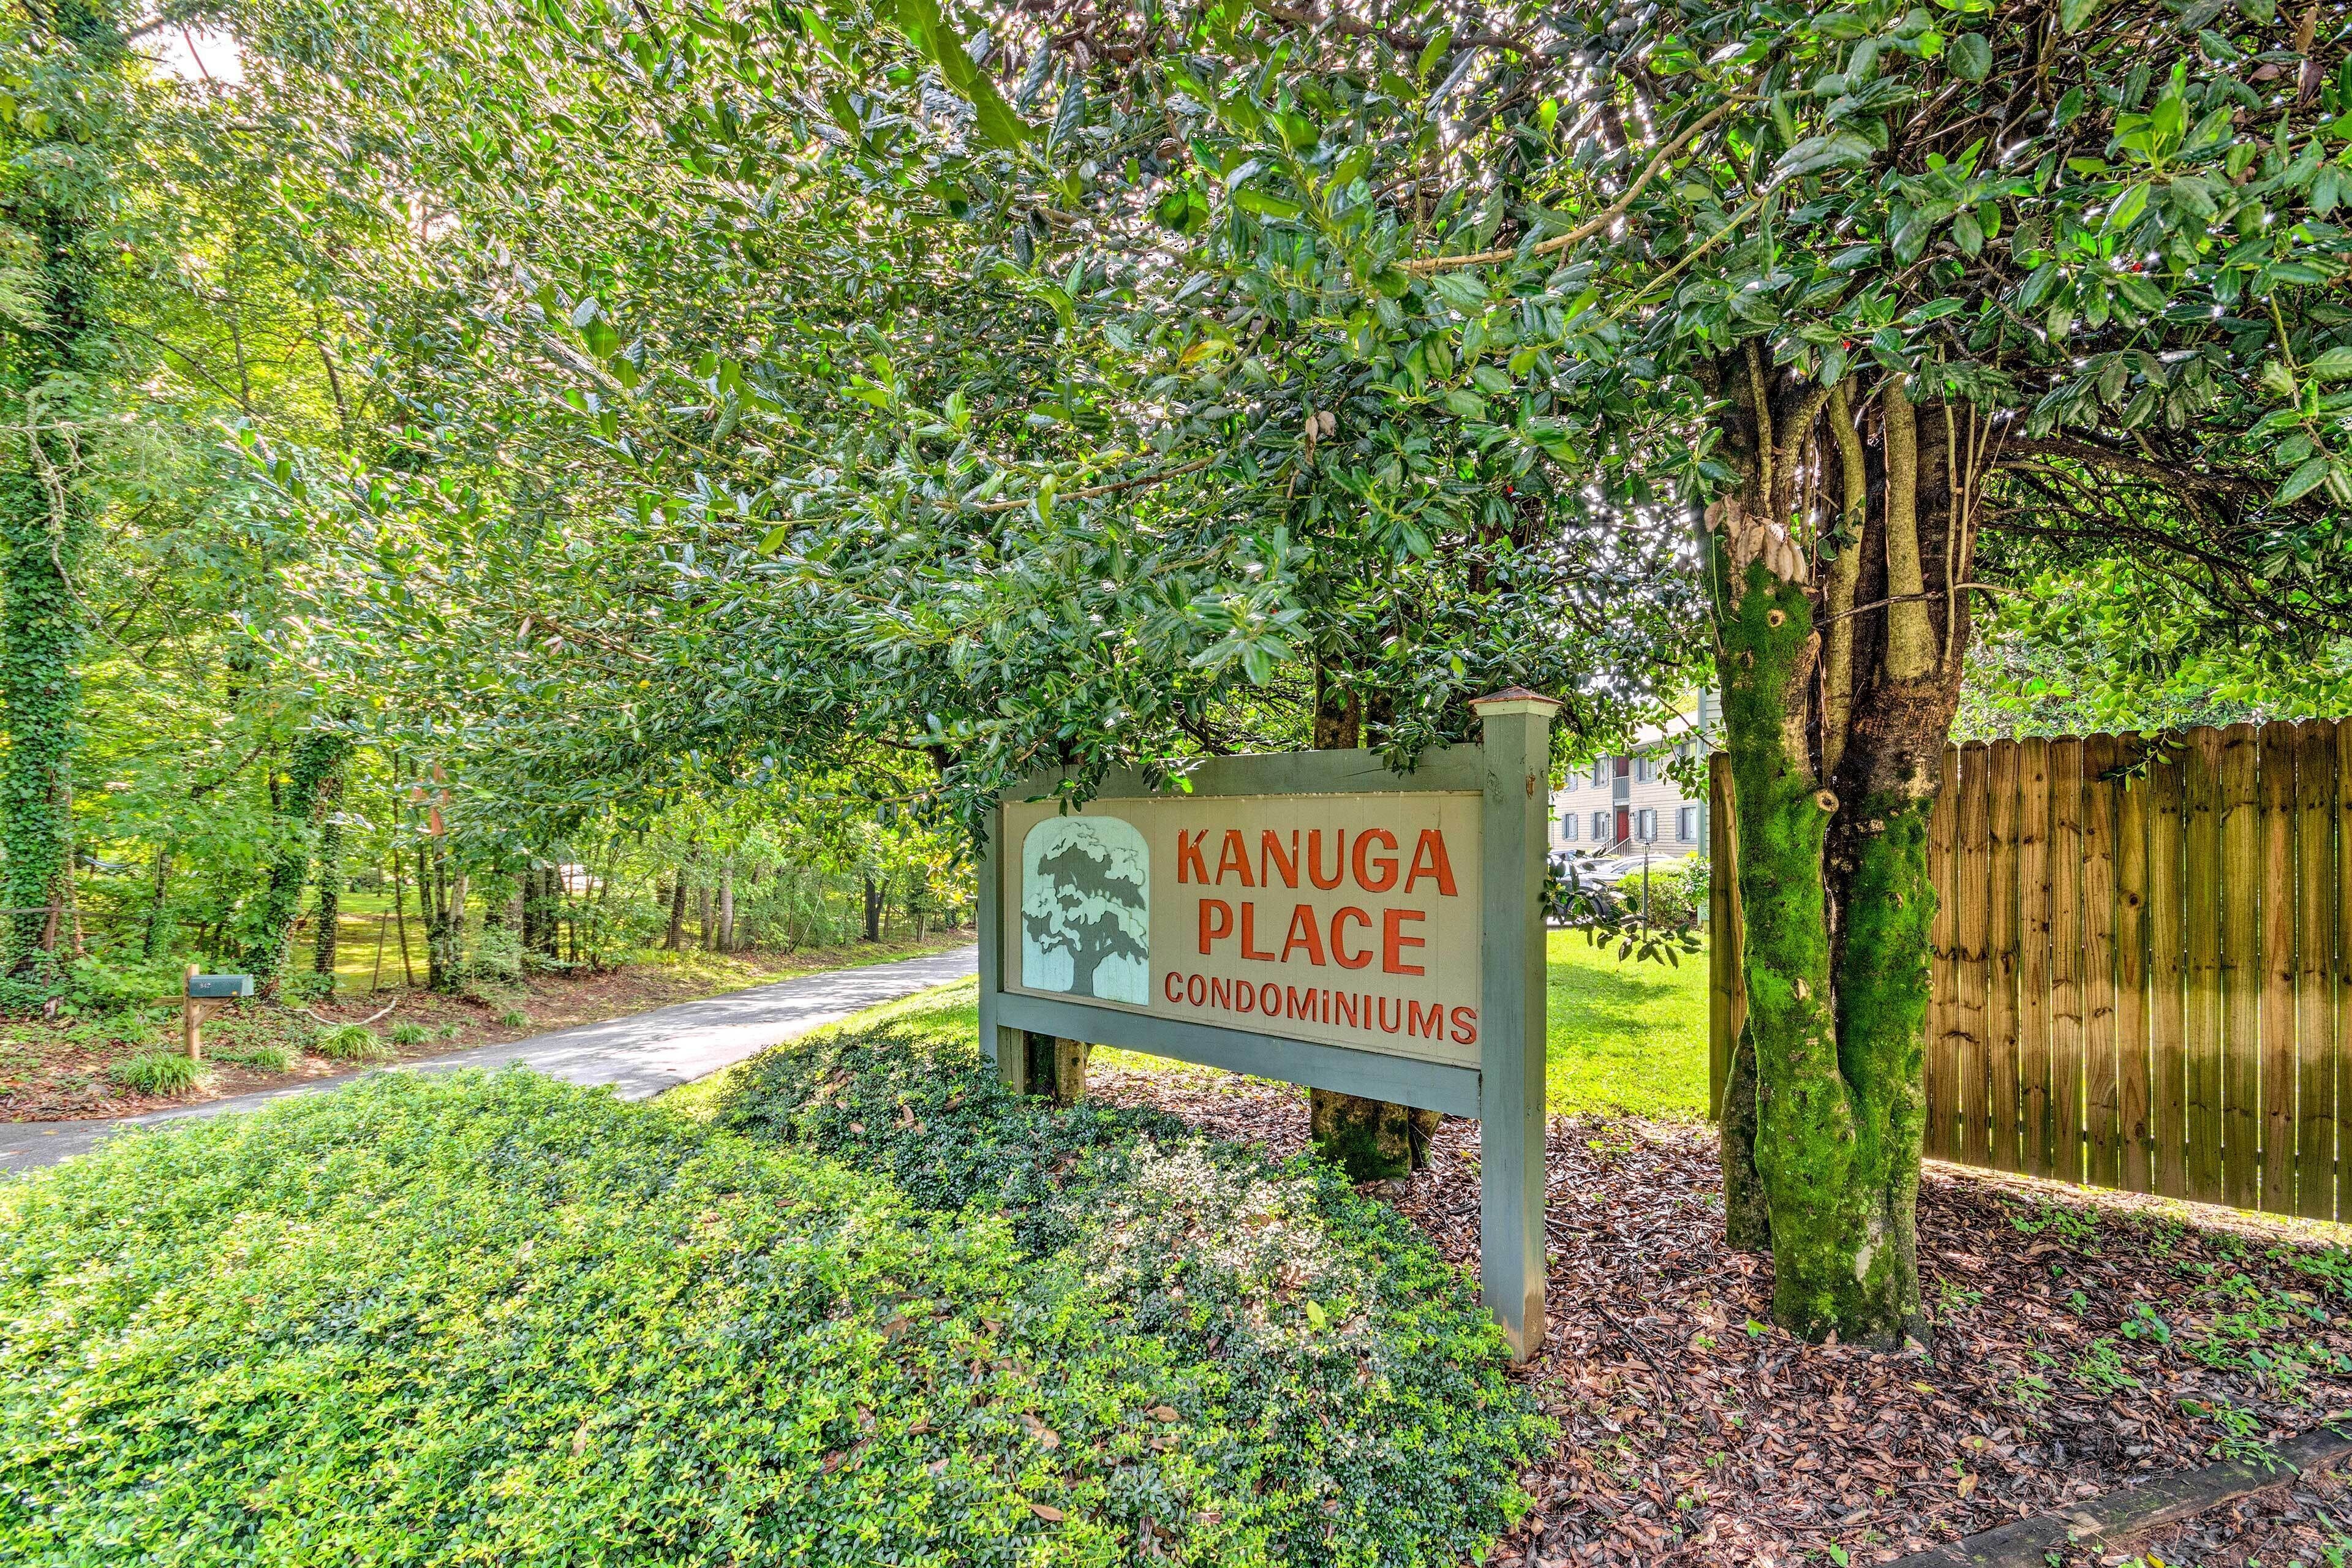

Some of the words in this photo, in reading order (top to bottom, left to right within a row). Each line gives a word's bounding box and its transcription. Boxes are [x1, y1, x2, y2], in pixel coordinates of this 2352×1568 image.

[1177, 828, 1458, 896] KANUGA
[1198, 899, 1425, 976] PLACE
[1164, 971, 1477, 1044] CONDOMINIUMS
